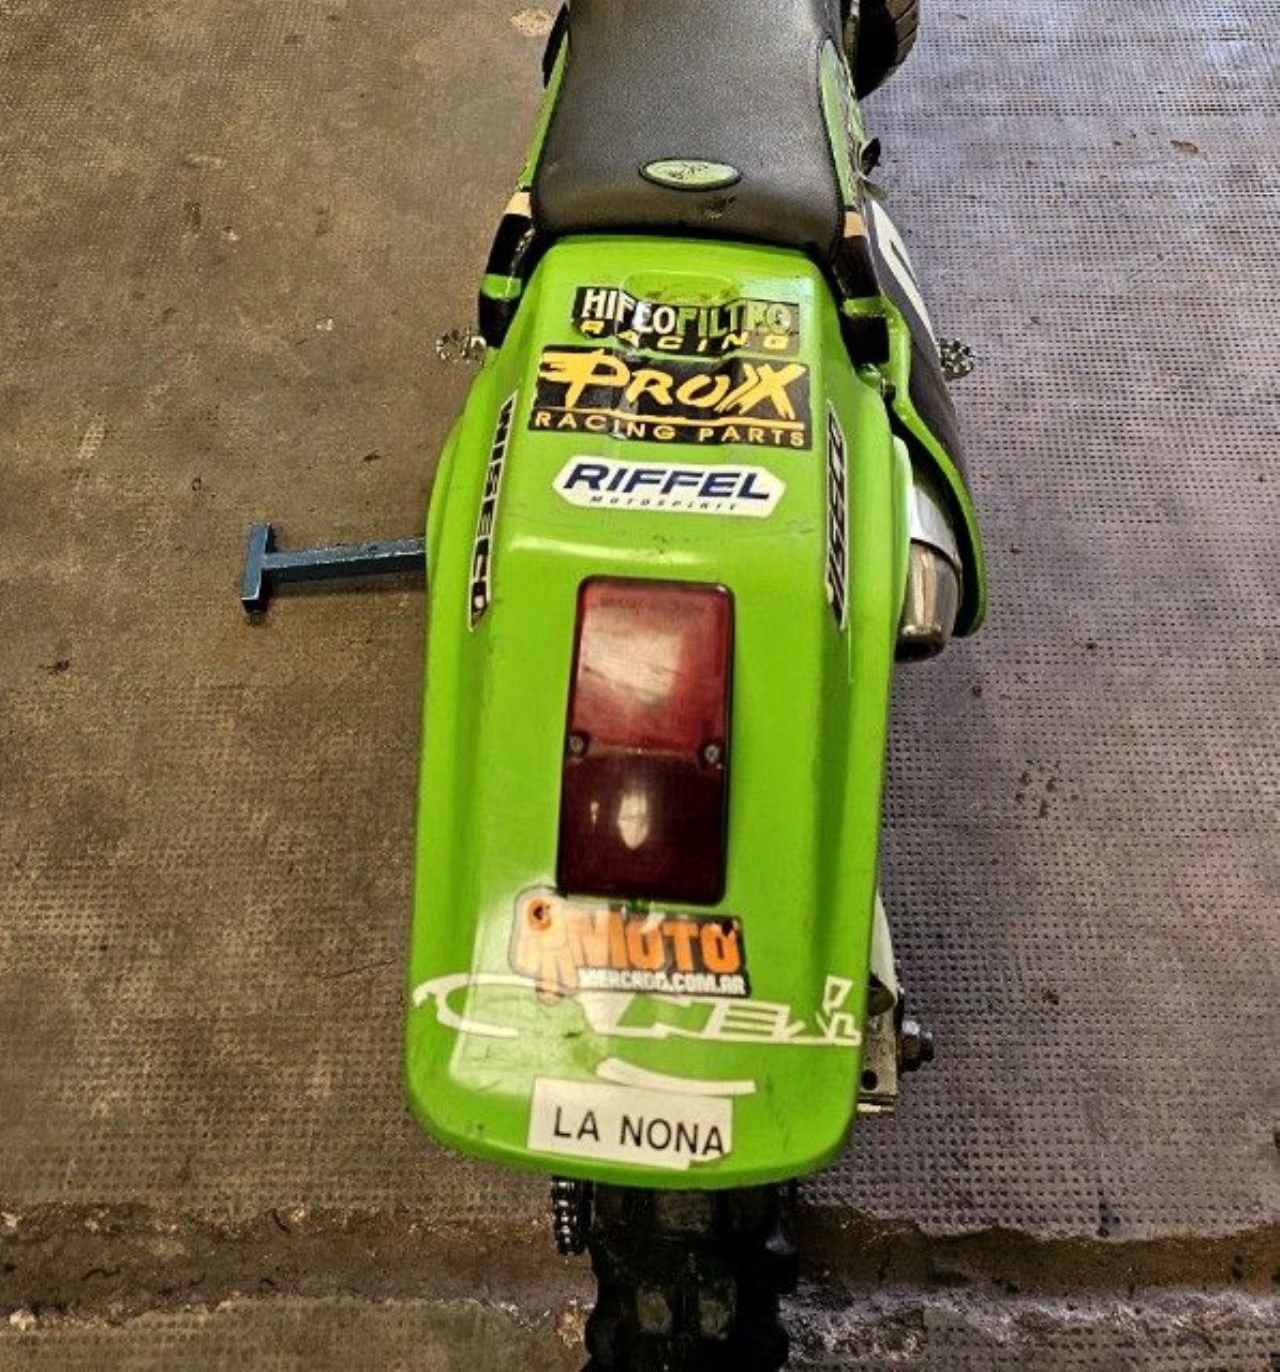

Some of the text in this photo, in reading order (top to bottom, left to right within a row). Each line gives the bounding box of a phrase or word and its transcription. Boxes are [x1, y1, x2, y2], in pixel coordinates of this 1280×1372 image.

[580, 320, 790, 352] RACING
[534, 411, 805, 446] RACING PARTS
[563, 464, 770, 500] RIFFEL
[566, 905, 742, 974] MOTO
[553, 1106, 726, 1157] LA NONA
